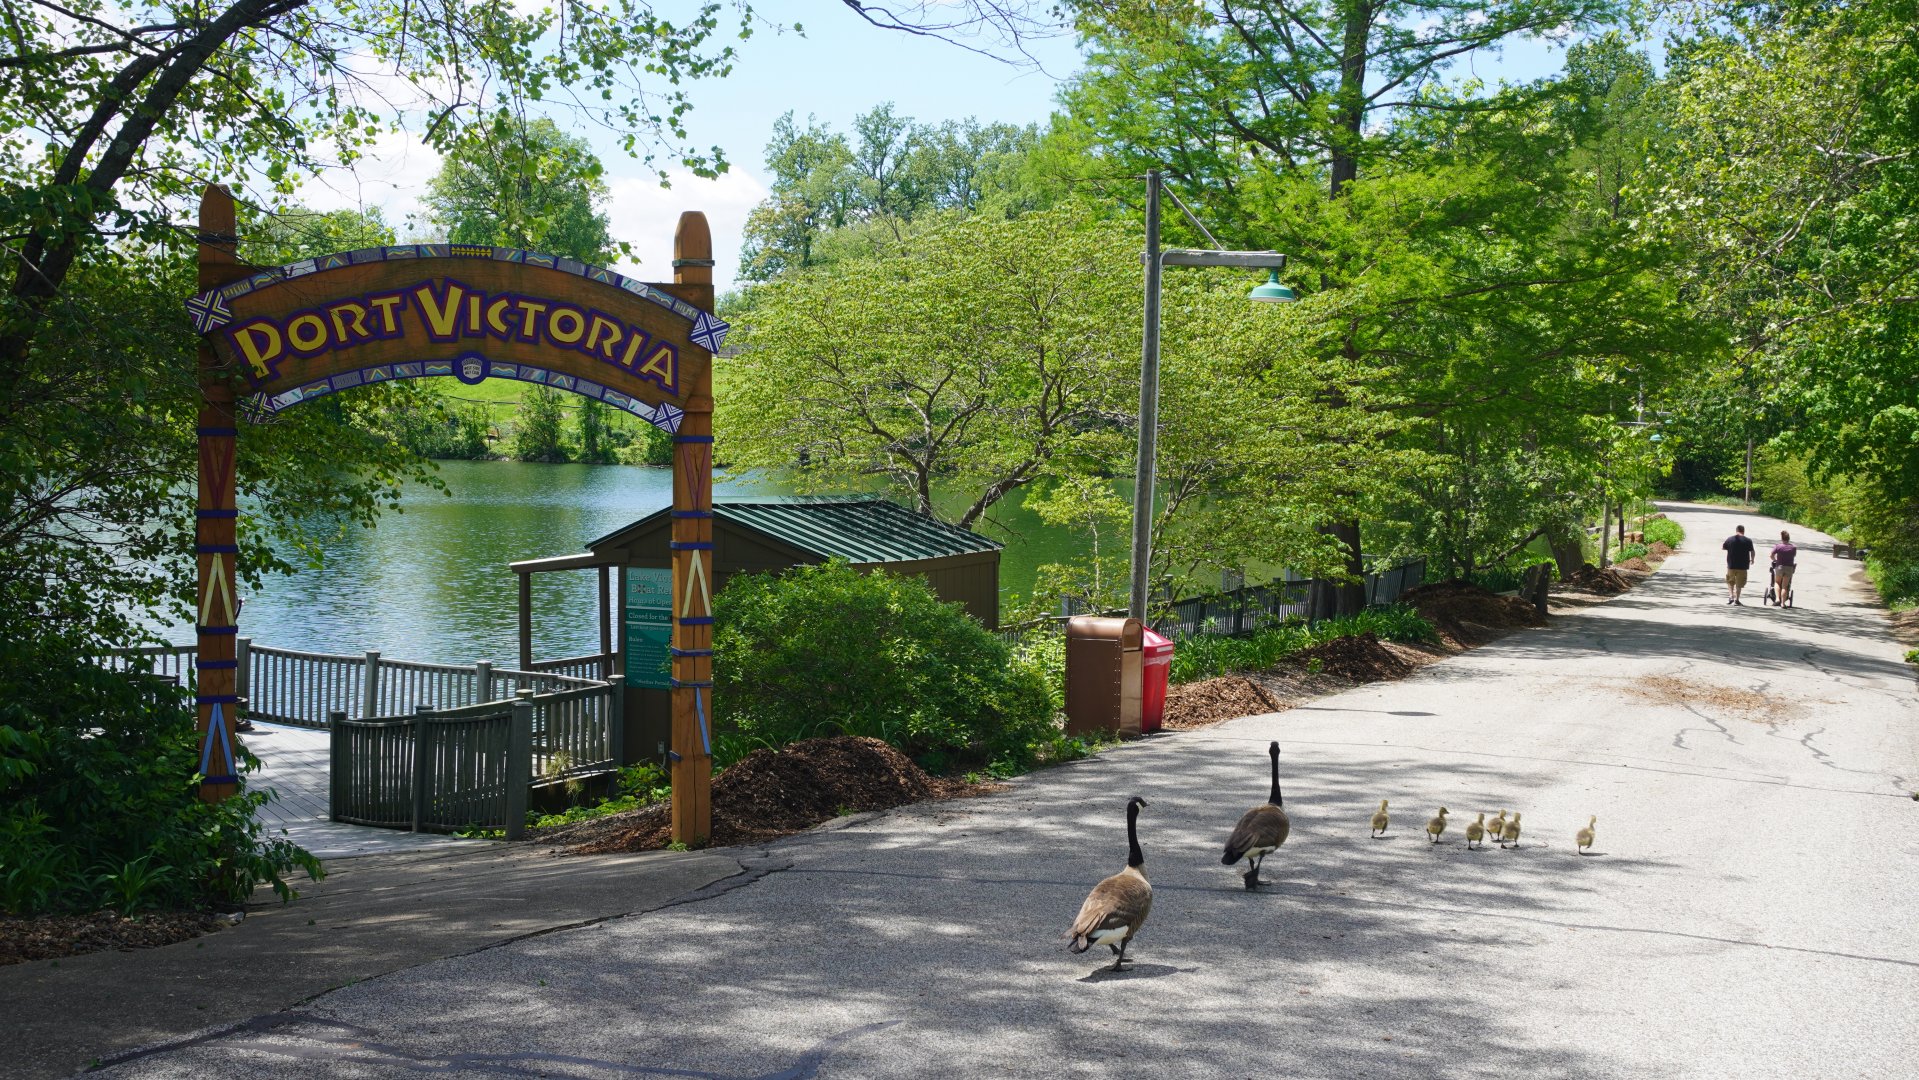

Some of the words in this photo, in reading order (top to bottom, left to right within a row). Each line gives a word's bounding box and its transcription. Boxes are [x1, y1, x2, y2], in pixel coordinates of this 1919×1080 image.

[231, 294, 402, 381] PORT
[415, 284, 674, 388] VICTORIA
[629, 571, 650, 581] Lake
